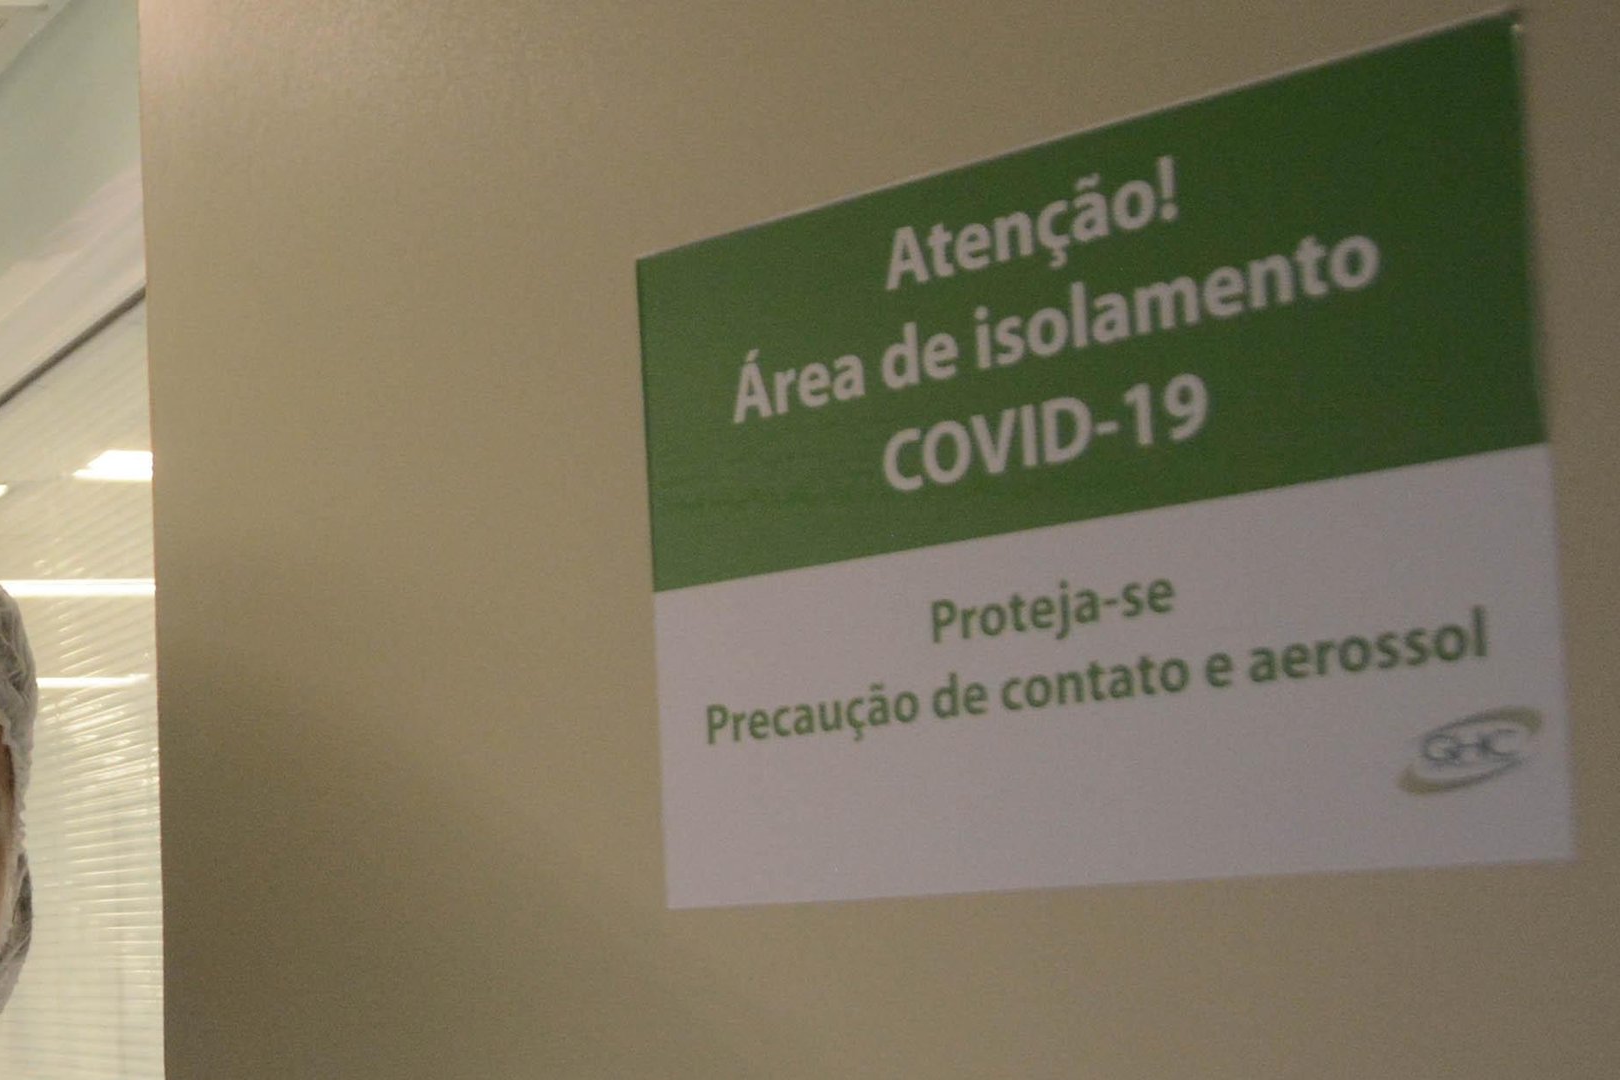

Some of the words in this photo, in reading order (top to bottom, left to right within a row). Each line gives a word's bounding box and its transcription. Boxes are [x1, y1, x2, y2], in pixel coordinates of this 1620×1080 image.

[884, 155, 1180, 291] Atenção!
[732, 347, 866, 424] Área
[881, 321, 958, 390] de
[974, 233, 1381, 369] isolamento
[881, 373, 1208, 493] COVID-19
[705, 681, 920, 746] Precaução
[931, 672, 989, 721] de
[1000, 652, 1190, 712] contato
[1204, 650, 1235, 688] e
[1248, 605, 1488, 683] aerossol
[930, 575, 1175, 644] Proteja-se
